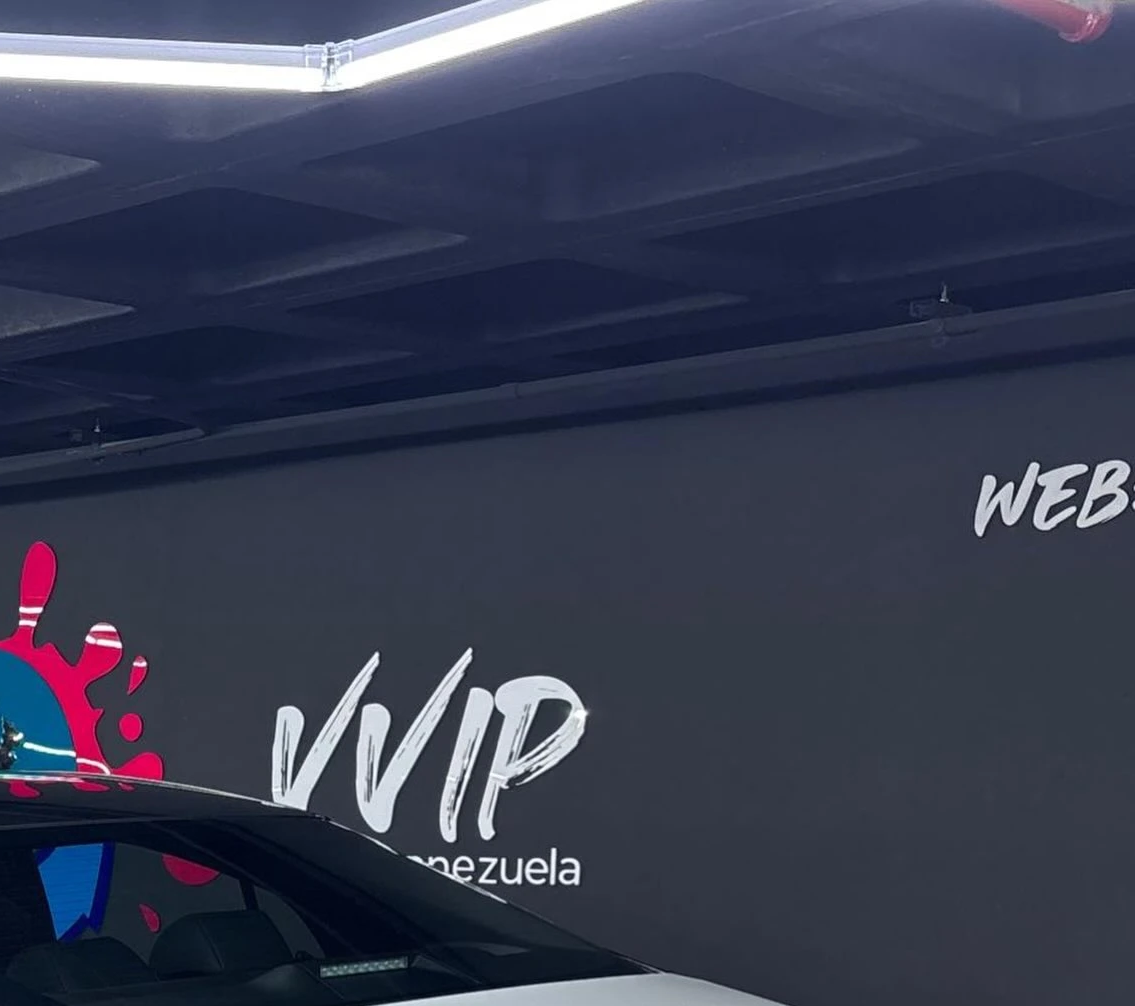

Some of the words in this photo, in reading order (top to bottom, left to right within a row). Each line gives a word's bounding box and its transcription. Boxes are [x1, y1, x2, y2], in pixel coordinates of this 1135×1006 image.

[973, 459, 1135, 538] WEB
[271, 646, 588, 843] VVIP
[407, 847, 582, 887] nezuela
